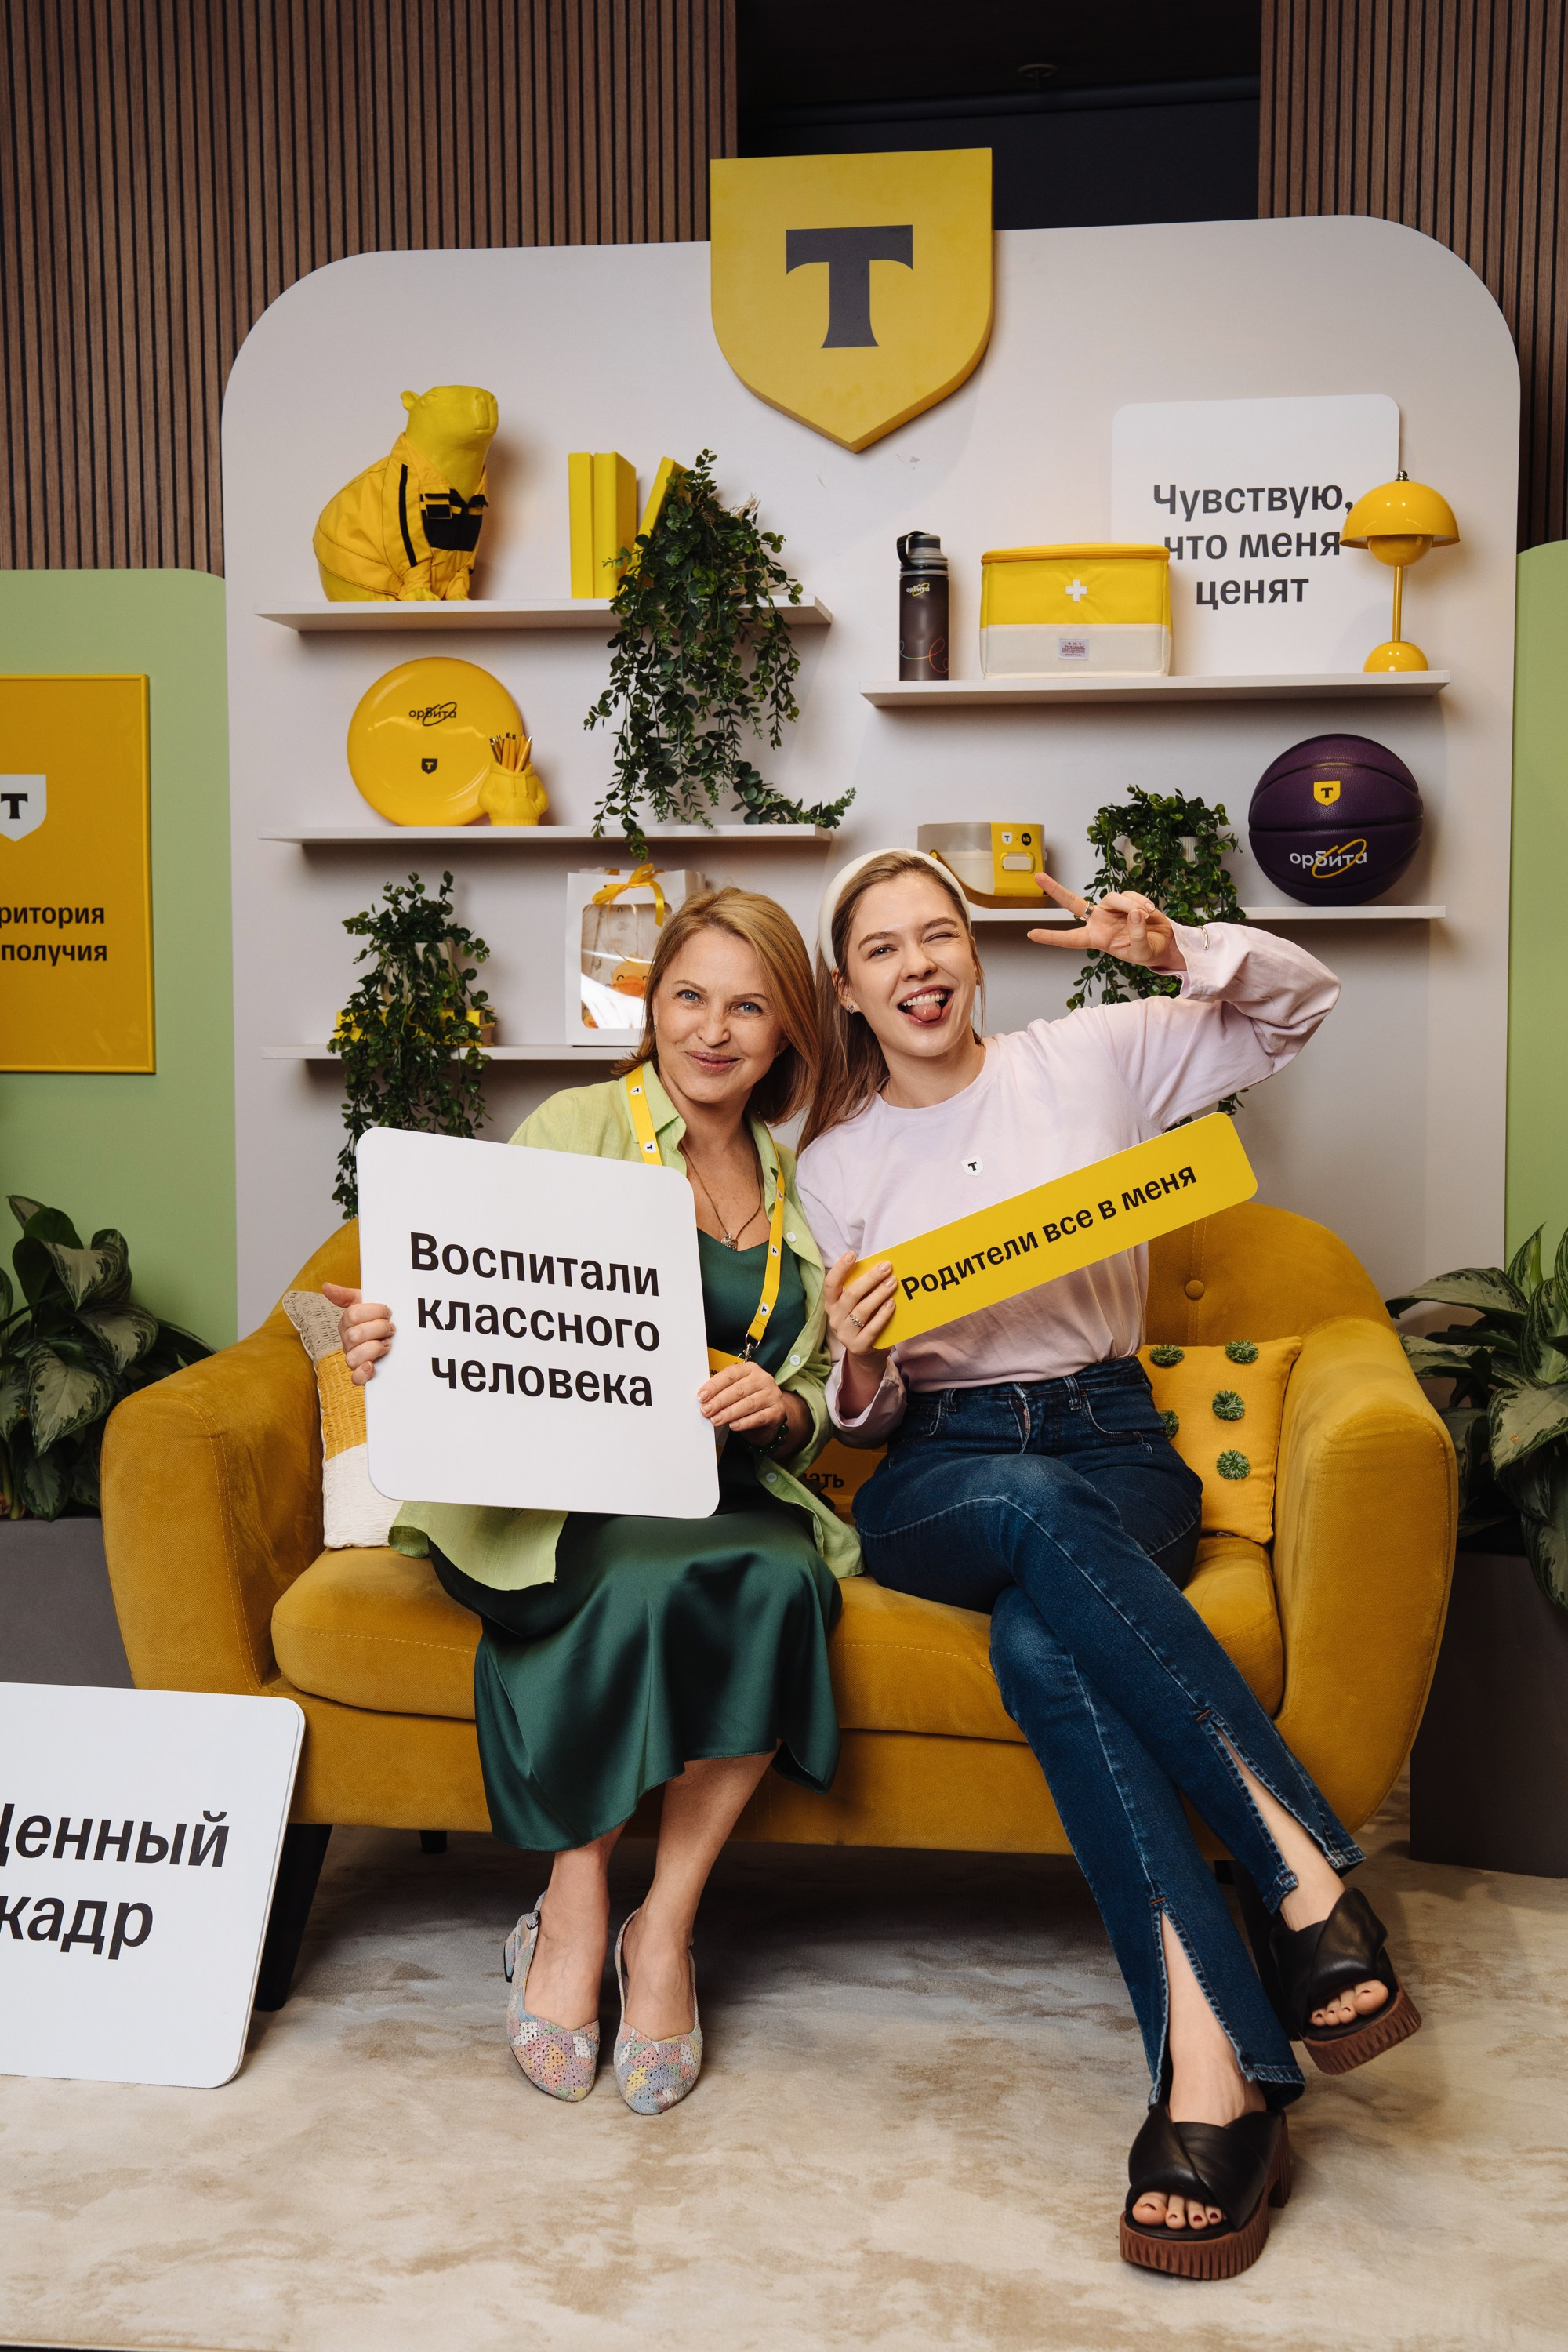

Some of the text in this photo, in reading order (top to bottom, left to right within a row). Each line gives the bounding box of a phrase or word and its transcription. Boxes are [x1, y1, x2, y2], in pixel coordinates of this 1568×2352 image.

[1153, 484, 1354, 523] Чувствую,
[1164, 531, 1341, 561] что меня
[1196, 578, 1310, 611] ценят
[408, 706, 457, 721] орбита
[1289, 848, 1367, 871] орбита
[900, 1166, 1197, 1301] Родители все в меня
[410, 1232, 659, 1297] Воспитали
[417, 1298, 660, 1352] классного
[431, 1357, 652, 1407] человека
[0, 1895, 153, 1961] кадр
